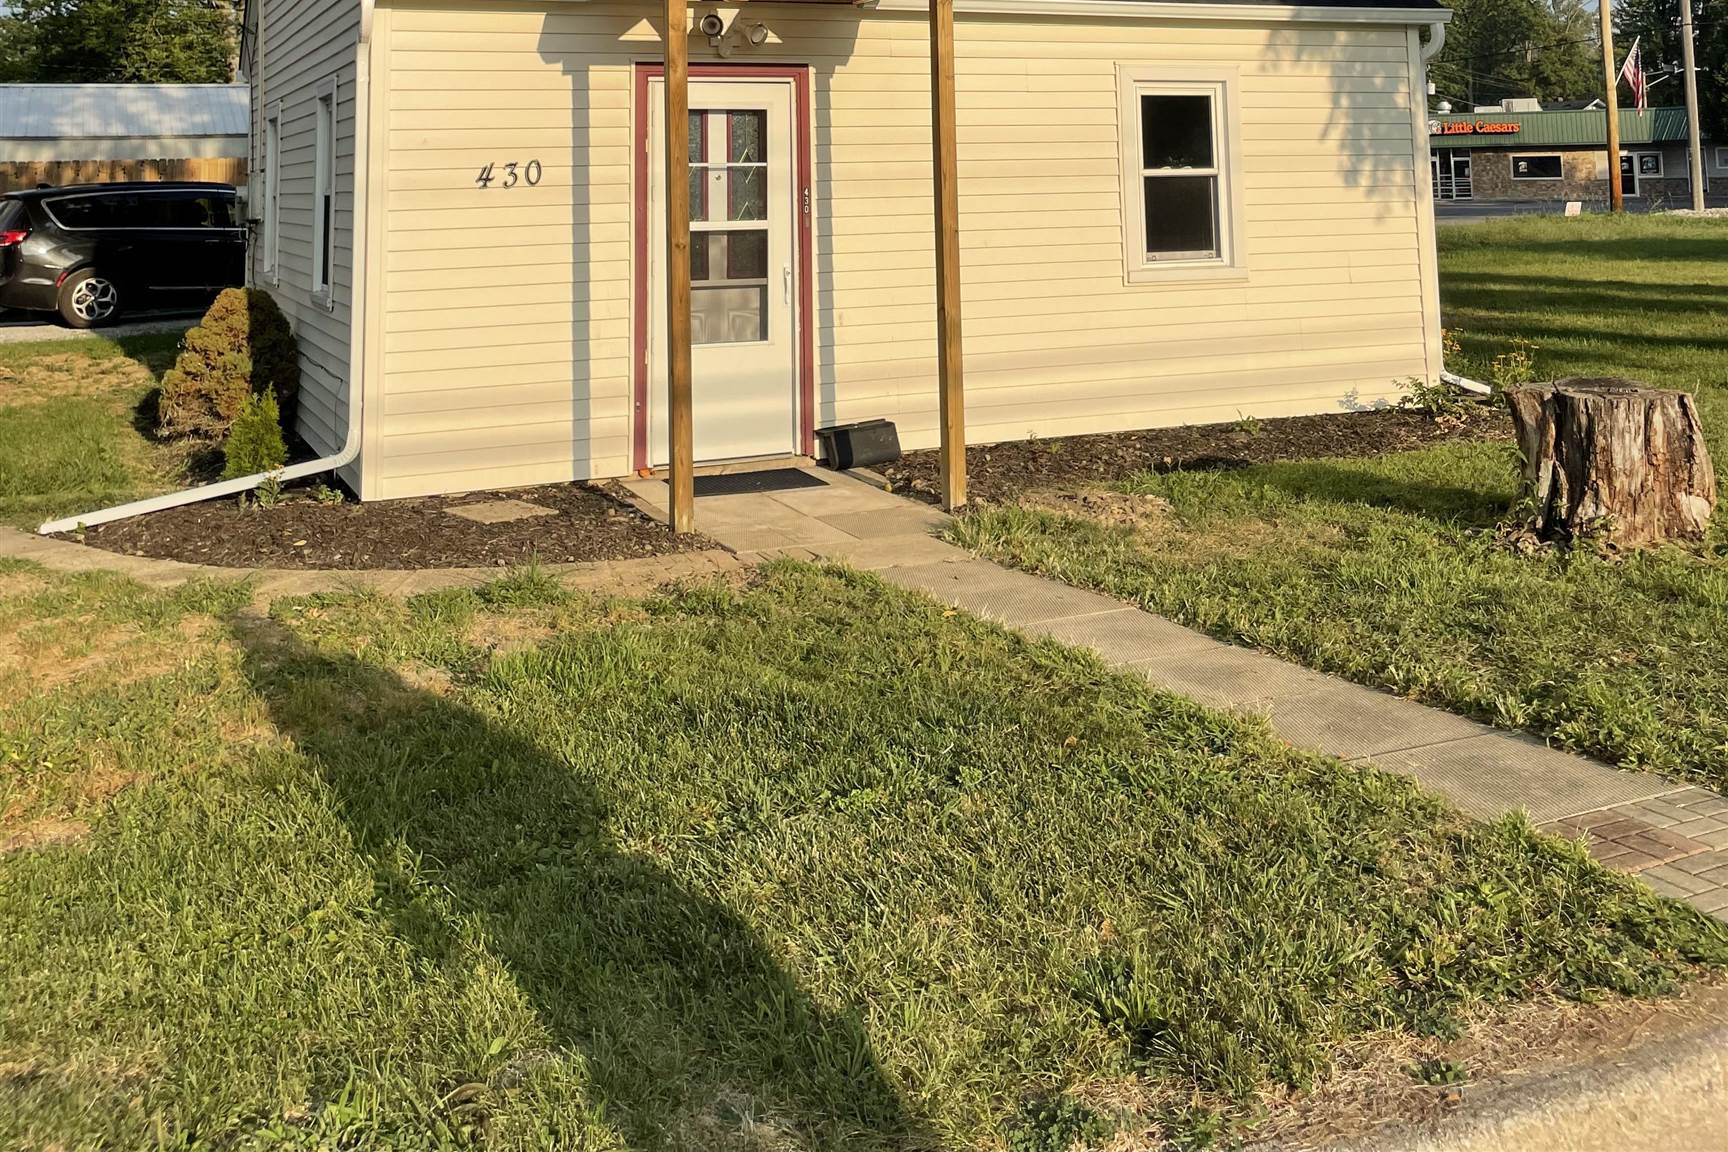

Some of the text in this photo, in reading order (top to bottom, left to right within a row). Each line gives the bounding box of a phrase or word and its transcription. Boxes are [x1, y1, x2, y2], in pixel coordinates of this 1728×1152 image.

[1443, 119, 1520, 134] Little Caesars
[475, 159, 542, 189] 430
